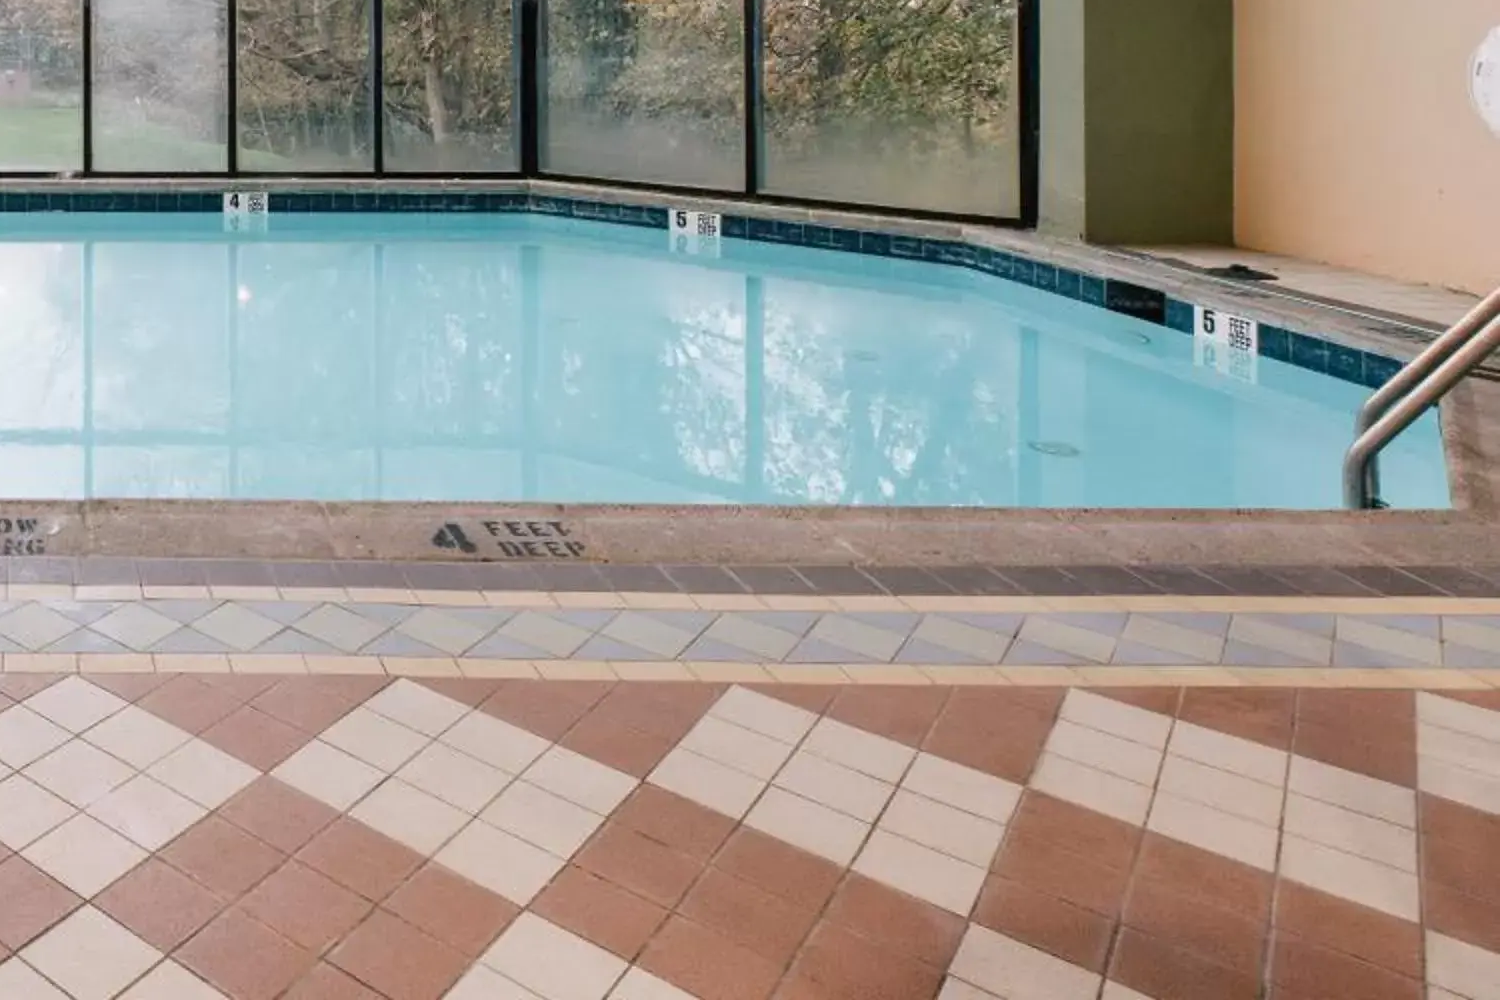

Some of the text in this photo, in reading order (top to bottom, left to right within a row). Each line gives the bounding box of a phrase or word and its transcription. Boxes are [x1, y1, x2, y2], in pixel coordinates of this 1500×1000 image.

[230, 193, 239, 209] 4
[676, 211, 687, 228] 5
[1203, 310, 1251, 337] 5 FEET
[431, 520, 572, 554] 4 FEET
[497, 540, 586, 558] DEEP
